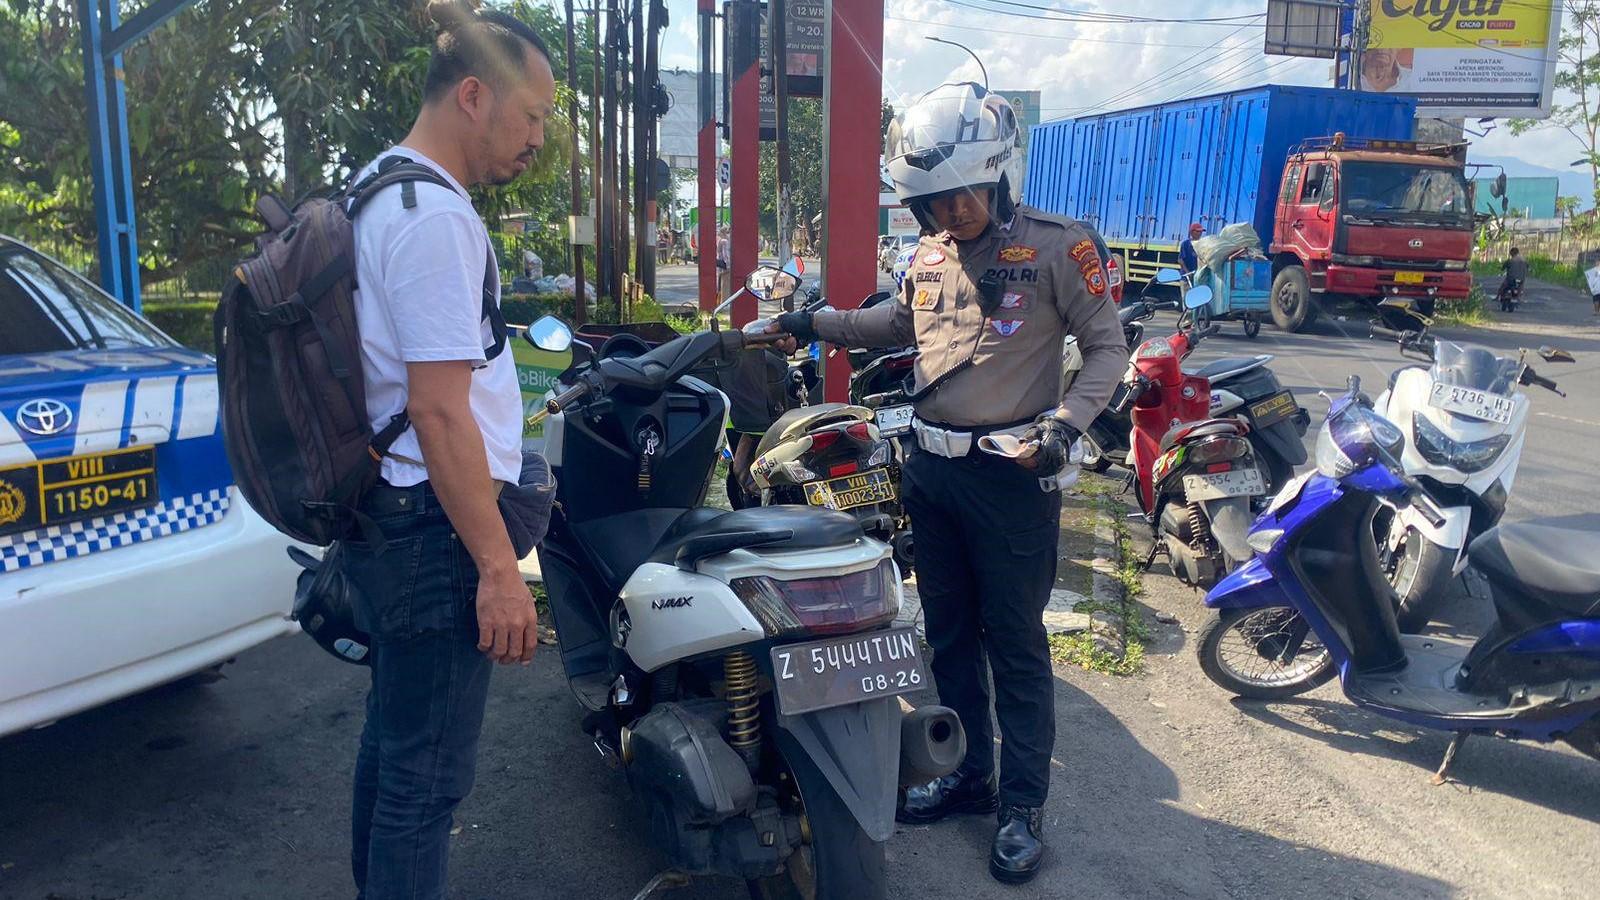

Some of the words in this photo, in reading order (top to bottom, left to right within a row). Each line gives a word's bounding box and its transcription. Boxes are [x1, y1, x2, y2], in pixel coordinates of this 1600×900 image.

[986, 268, 1039, 282] POLRI
[1435, 384, 1443, 396] Z
[1451, 387, 1486, 405] 5736
[878, 412, 886, 423] Z
[67, 457, 104, 480] VIII
[753, 457, 779, 476] POLISI
[847, 475, 867, 489] VIII
[1188, 478, 1196, 489] Z
[54, 478, 148, 515] 1150-41
[778, 652, 794, 680] Z
